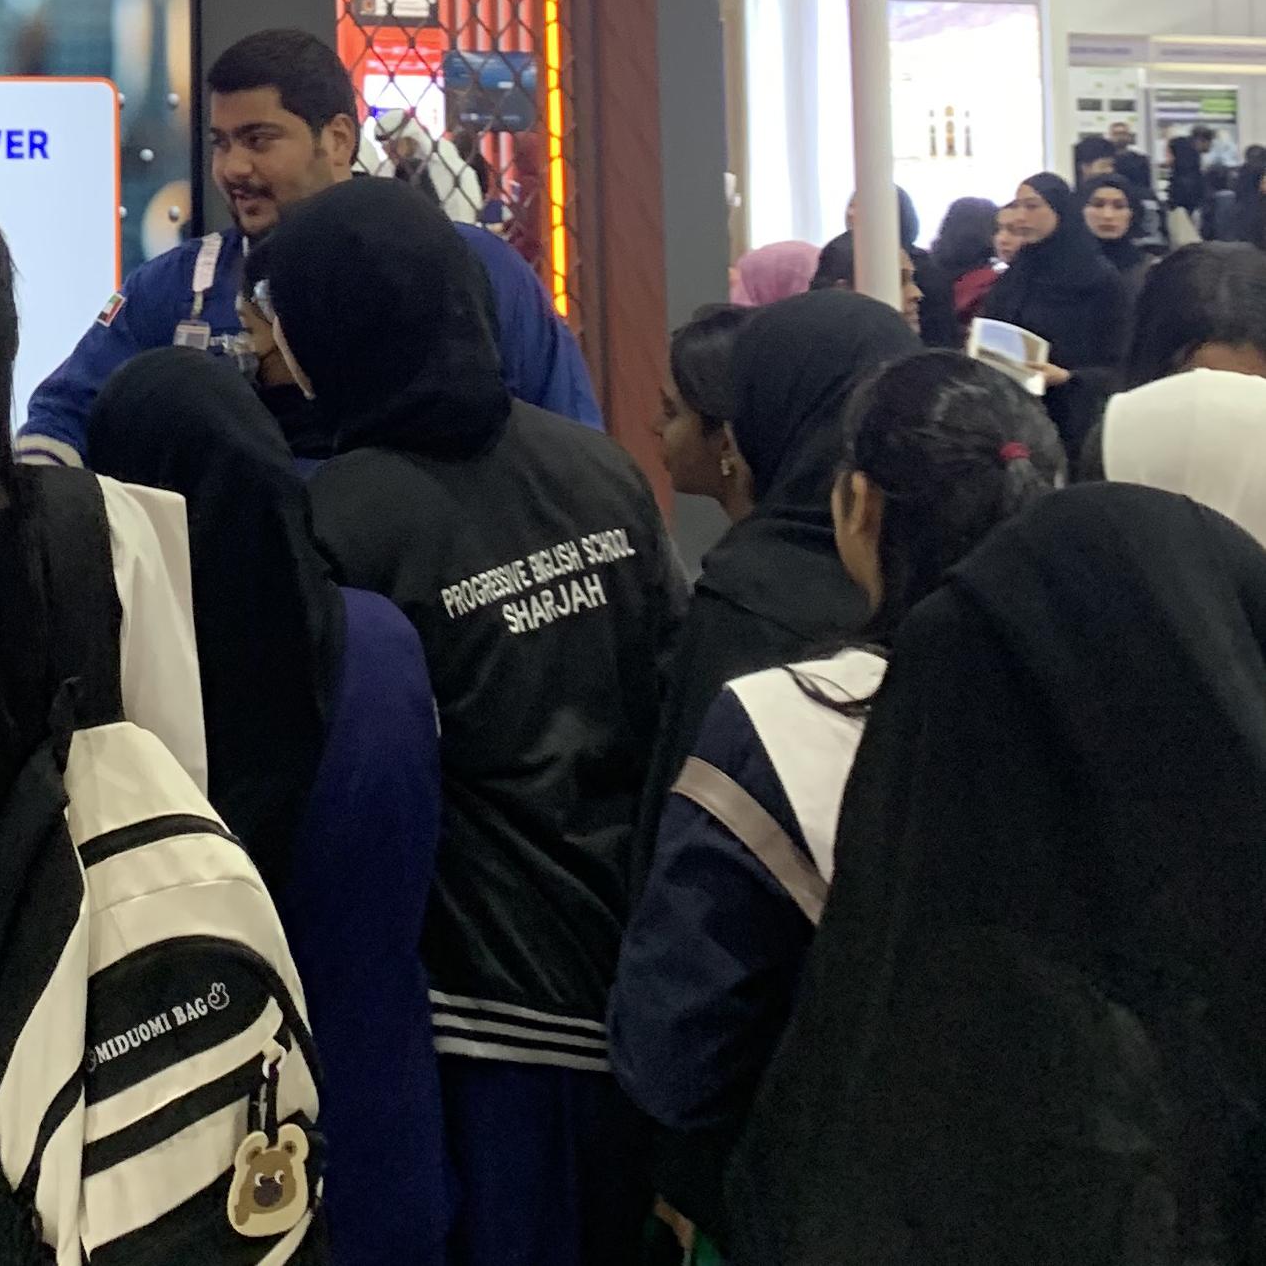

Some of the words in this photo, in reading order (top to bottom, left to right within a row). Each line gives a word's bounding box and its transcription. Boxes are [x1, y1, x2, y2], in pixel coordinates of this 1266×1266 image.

[440, 559, 533, 619] PROGRESSIVE
[526, 540, 584, 584] ENGLISH
[580, 528, 636, 565] SCHOOL
[501, 573, 607, 634] SHARJAH
[94, 1013, 172, 1064] MIDUOMI
[171, 997, 209, 1026] BAG
